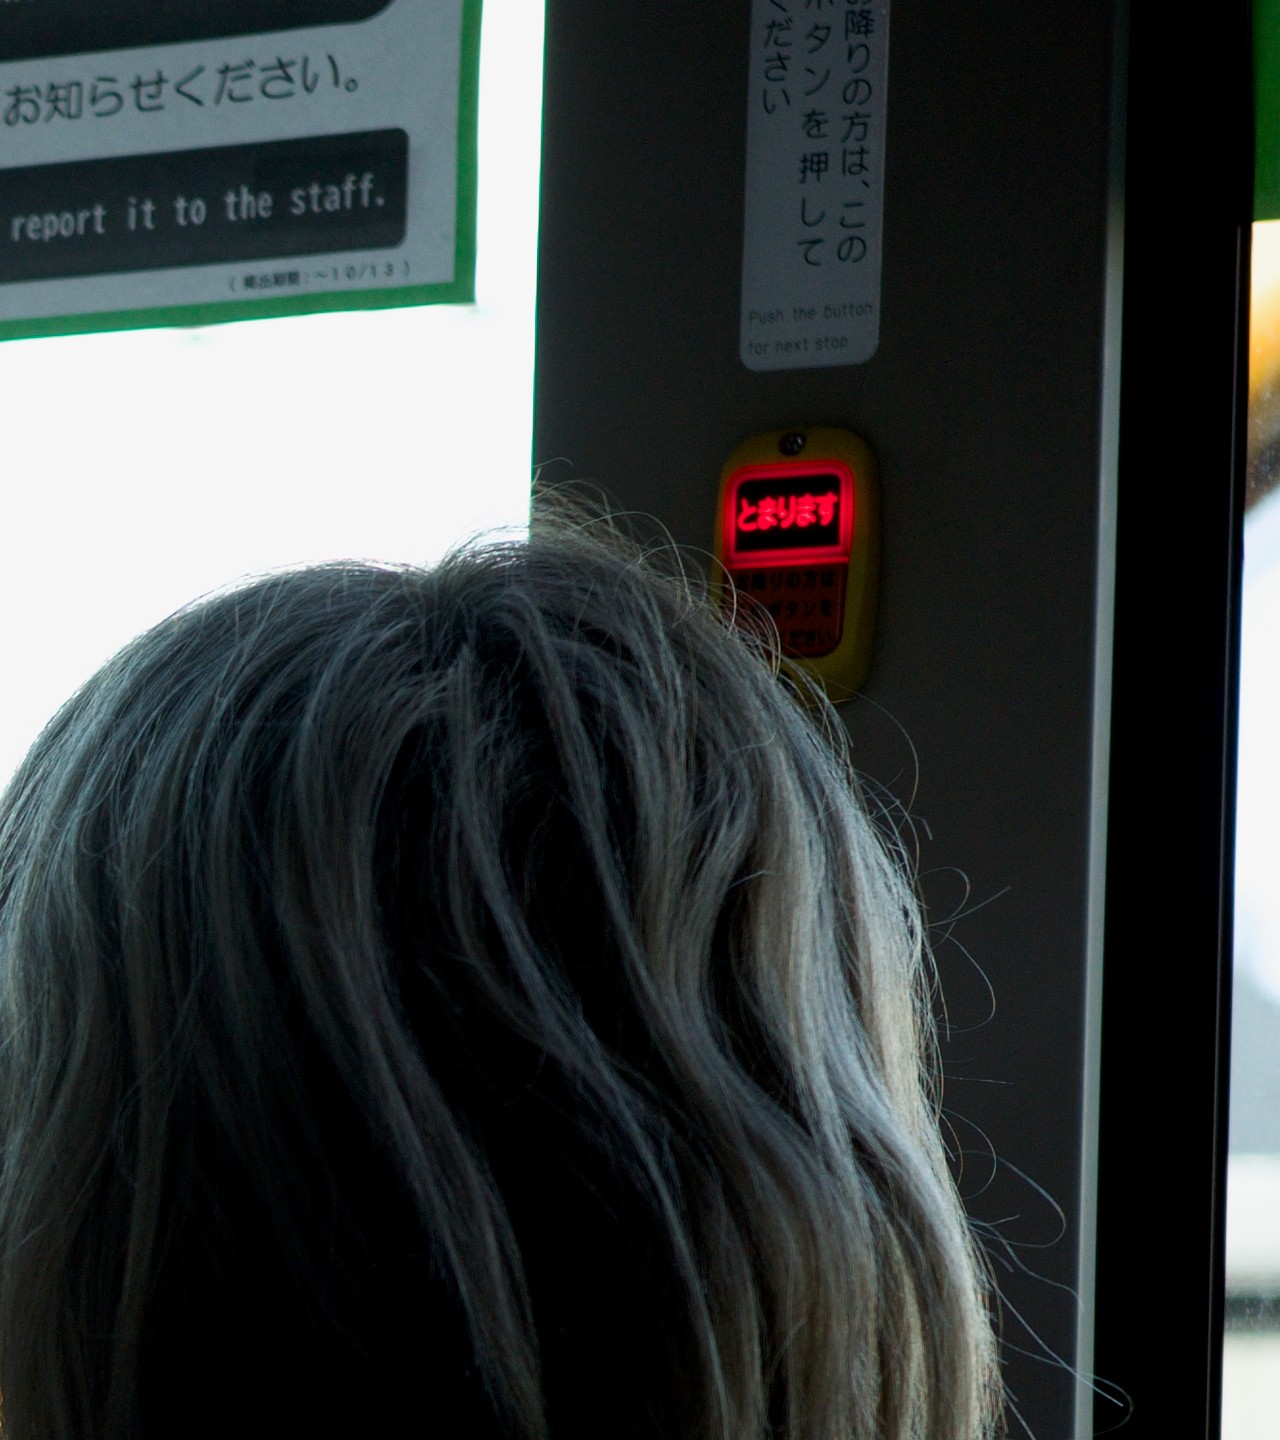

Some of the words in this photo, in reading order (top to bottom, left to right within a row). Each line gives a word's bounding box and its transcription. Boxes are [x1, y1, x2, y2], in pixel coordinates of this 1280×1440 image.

[9, 200, 106, 250] report
[127, 195, 156, 230] it
[175, 191, 207, 227] to
[224, 184, 274, 222] the
[289, 173, 387, 216] staff.
